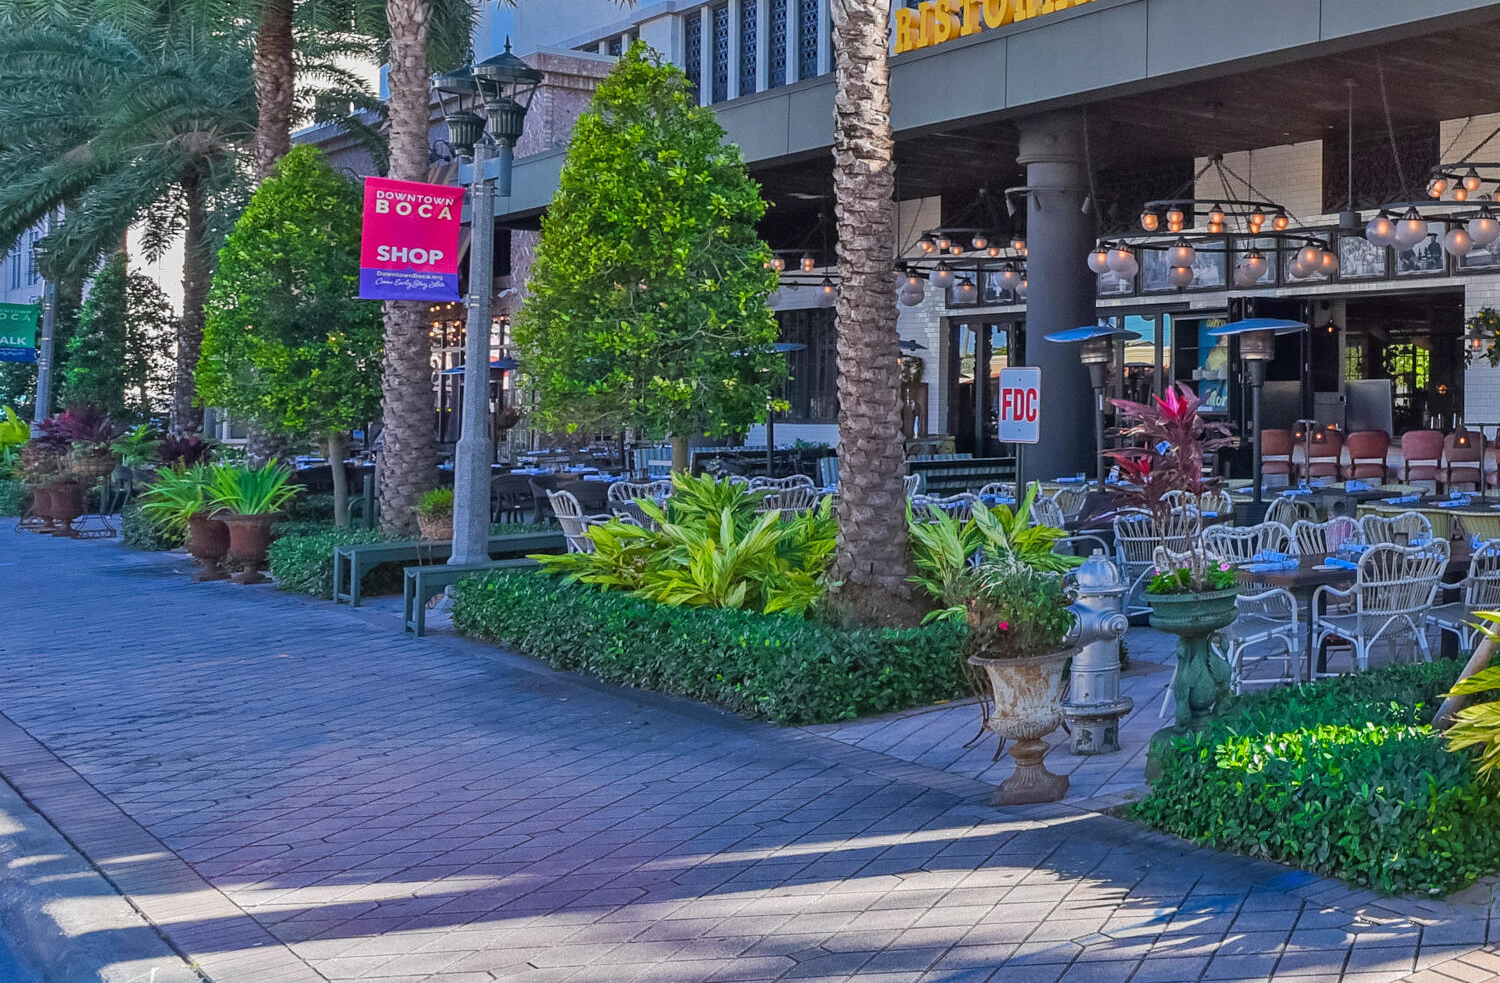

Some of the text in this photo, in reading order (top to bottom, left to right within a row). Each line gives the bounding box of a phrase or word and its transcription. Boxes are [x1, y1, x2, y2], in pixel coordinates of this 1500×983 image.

[376, 190, 454, 206] DOWNTOWN
[375, 199, 453, 221] BOCA
[376, 245, 444, 265] SHOP
[0, 312, 32, 321] OCA
[0, 336, 27, 346] ALK
[1002, 387, 1038, 423] FDC
